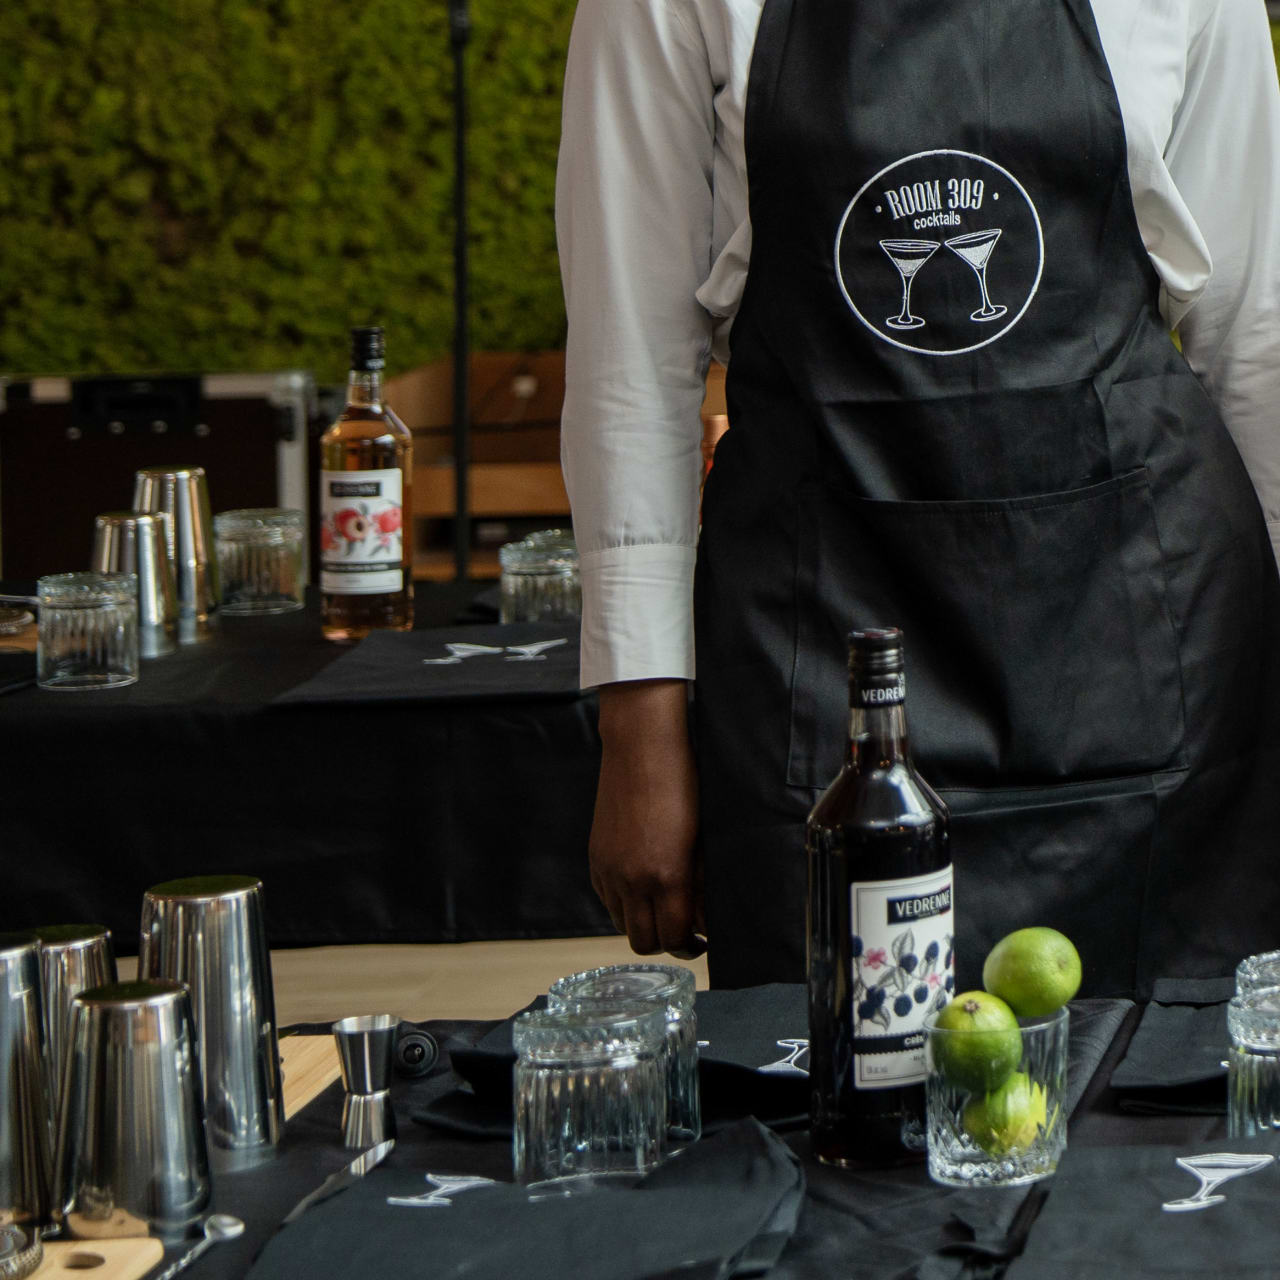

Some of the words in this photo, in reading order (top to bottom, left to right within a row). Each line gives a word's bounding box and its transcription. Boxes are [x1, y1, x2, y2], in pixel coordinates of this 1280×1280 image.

[884, 180, 941, 220] ROOM
[948, 178, 984, 210] 309
[914, 211, 961, 229] cocktails
[895, 889, 950, 918] VEDRENNE
